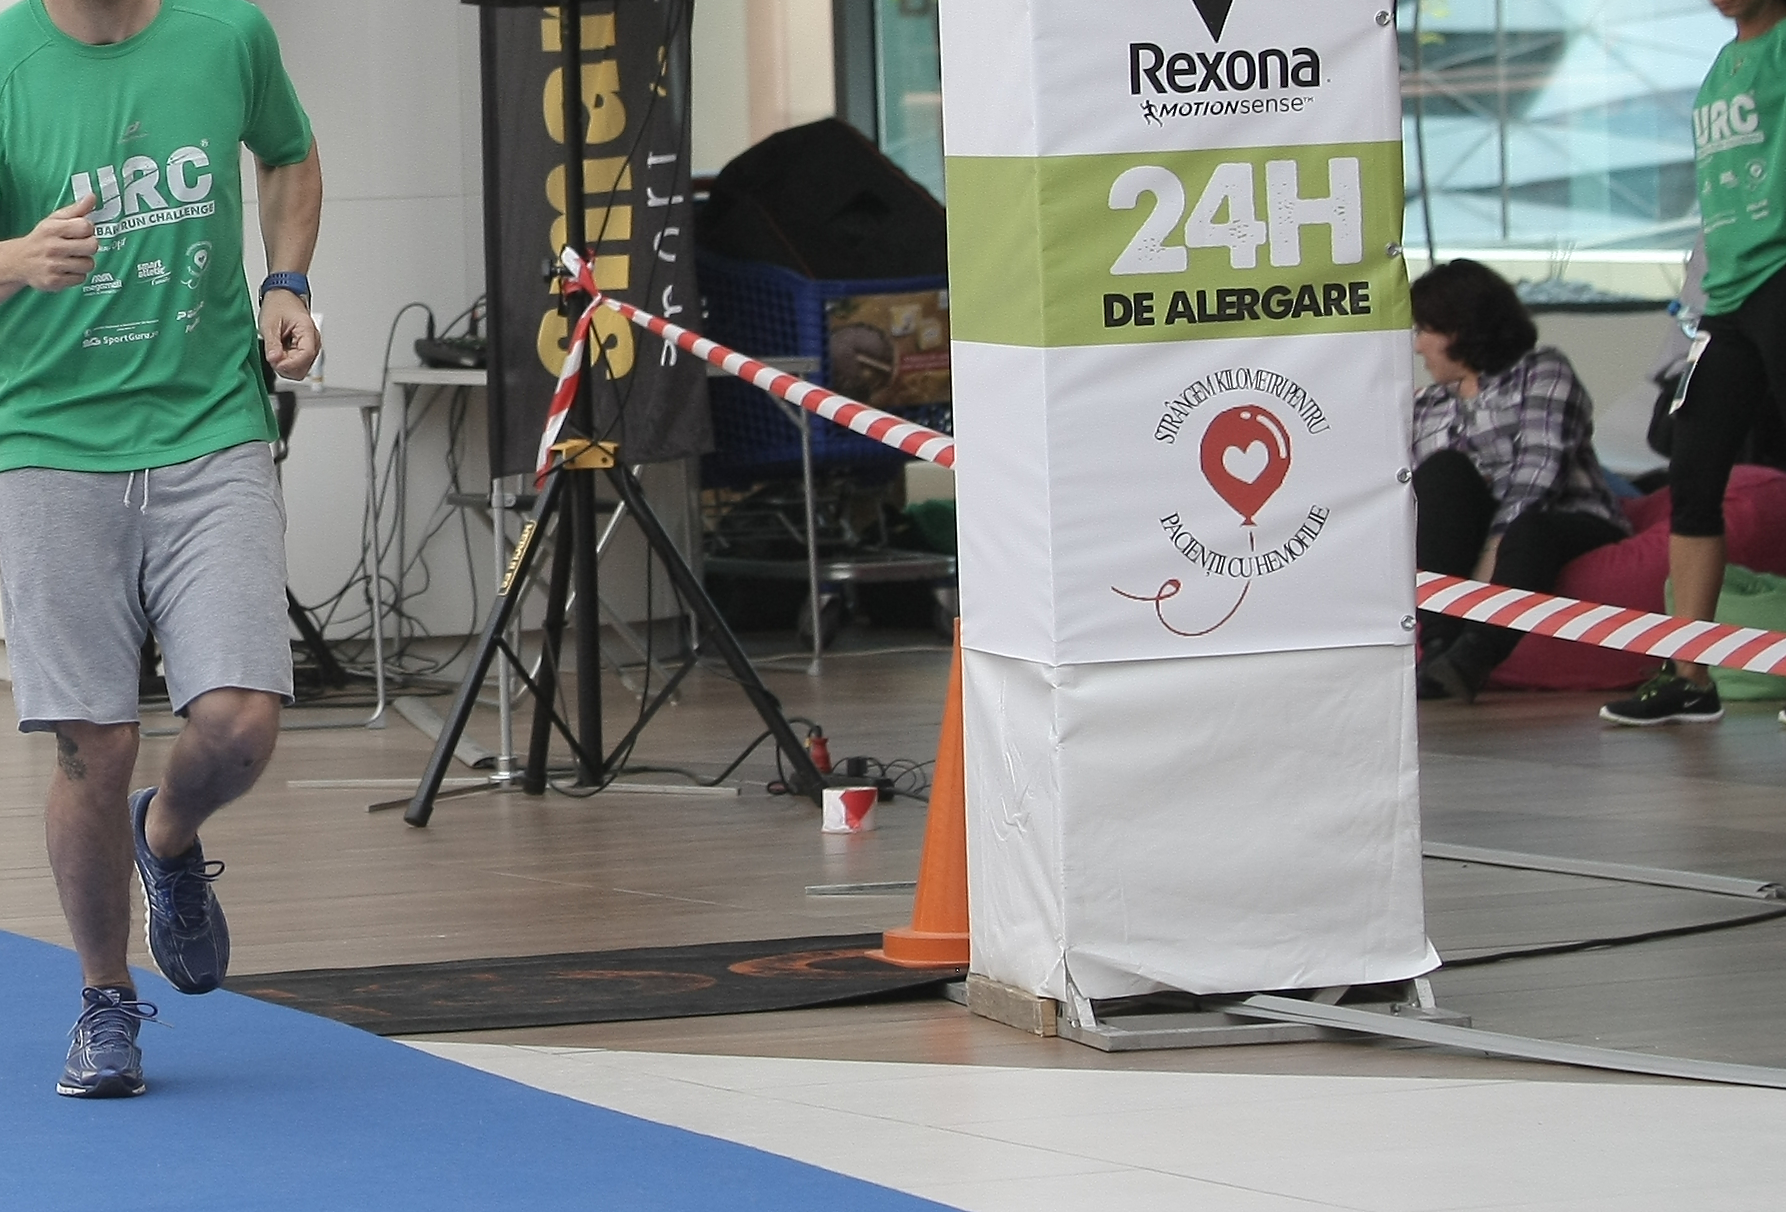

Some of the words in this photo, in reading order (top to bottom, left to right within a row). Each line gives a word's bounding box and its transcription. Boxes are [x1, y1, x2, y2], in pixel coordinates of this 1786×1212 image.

[1129, 41, 1321, 96] Rexona
[1693, 93, 1759, 146] URC
[71, 145, 213, 225] URC
[122, 216, 146, 231] RUN
[149, 202, 214, 225] CHALLENGE
[1107, 156, 1365, 277] 24H
[1103, 292, 1155, 328] DE
[1164, 281, 1371, 326] ALERGARE
[1285, 375, 1330, 435] PENTRU
[1228, 557, 1253, 577] CU
[1257, 505, 1330, 576] HEMOFILIE
